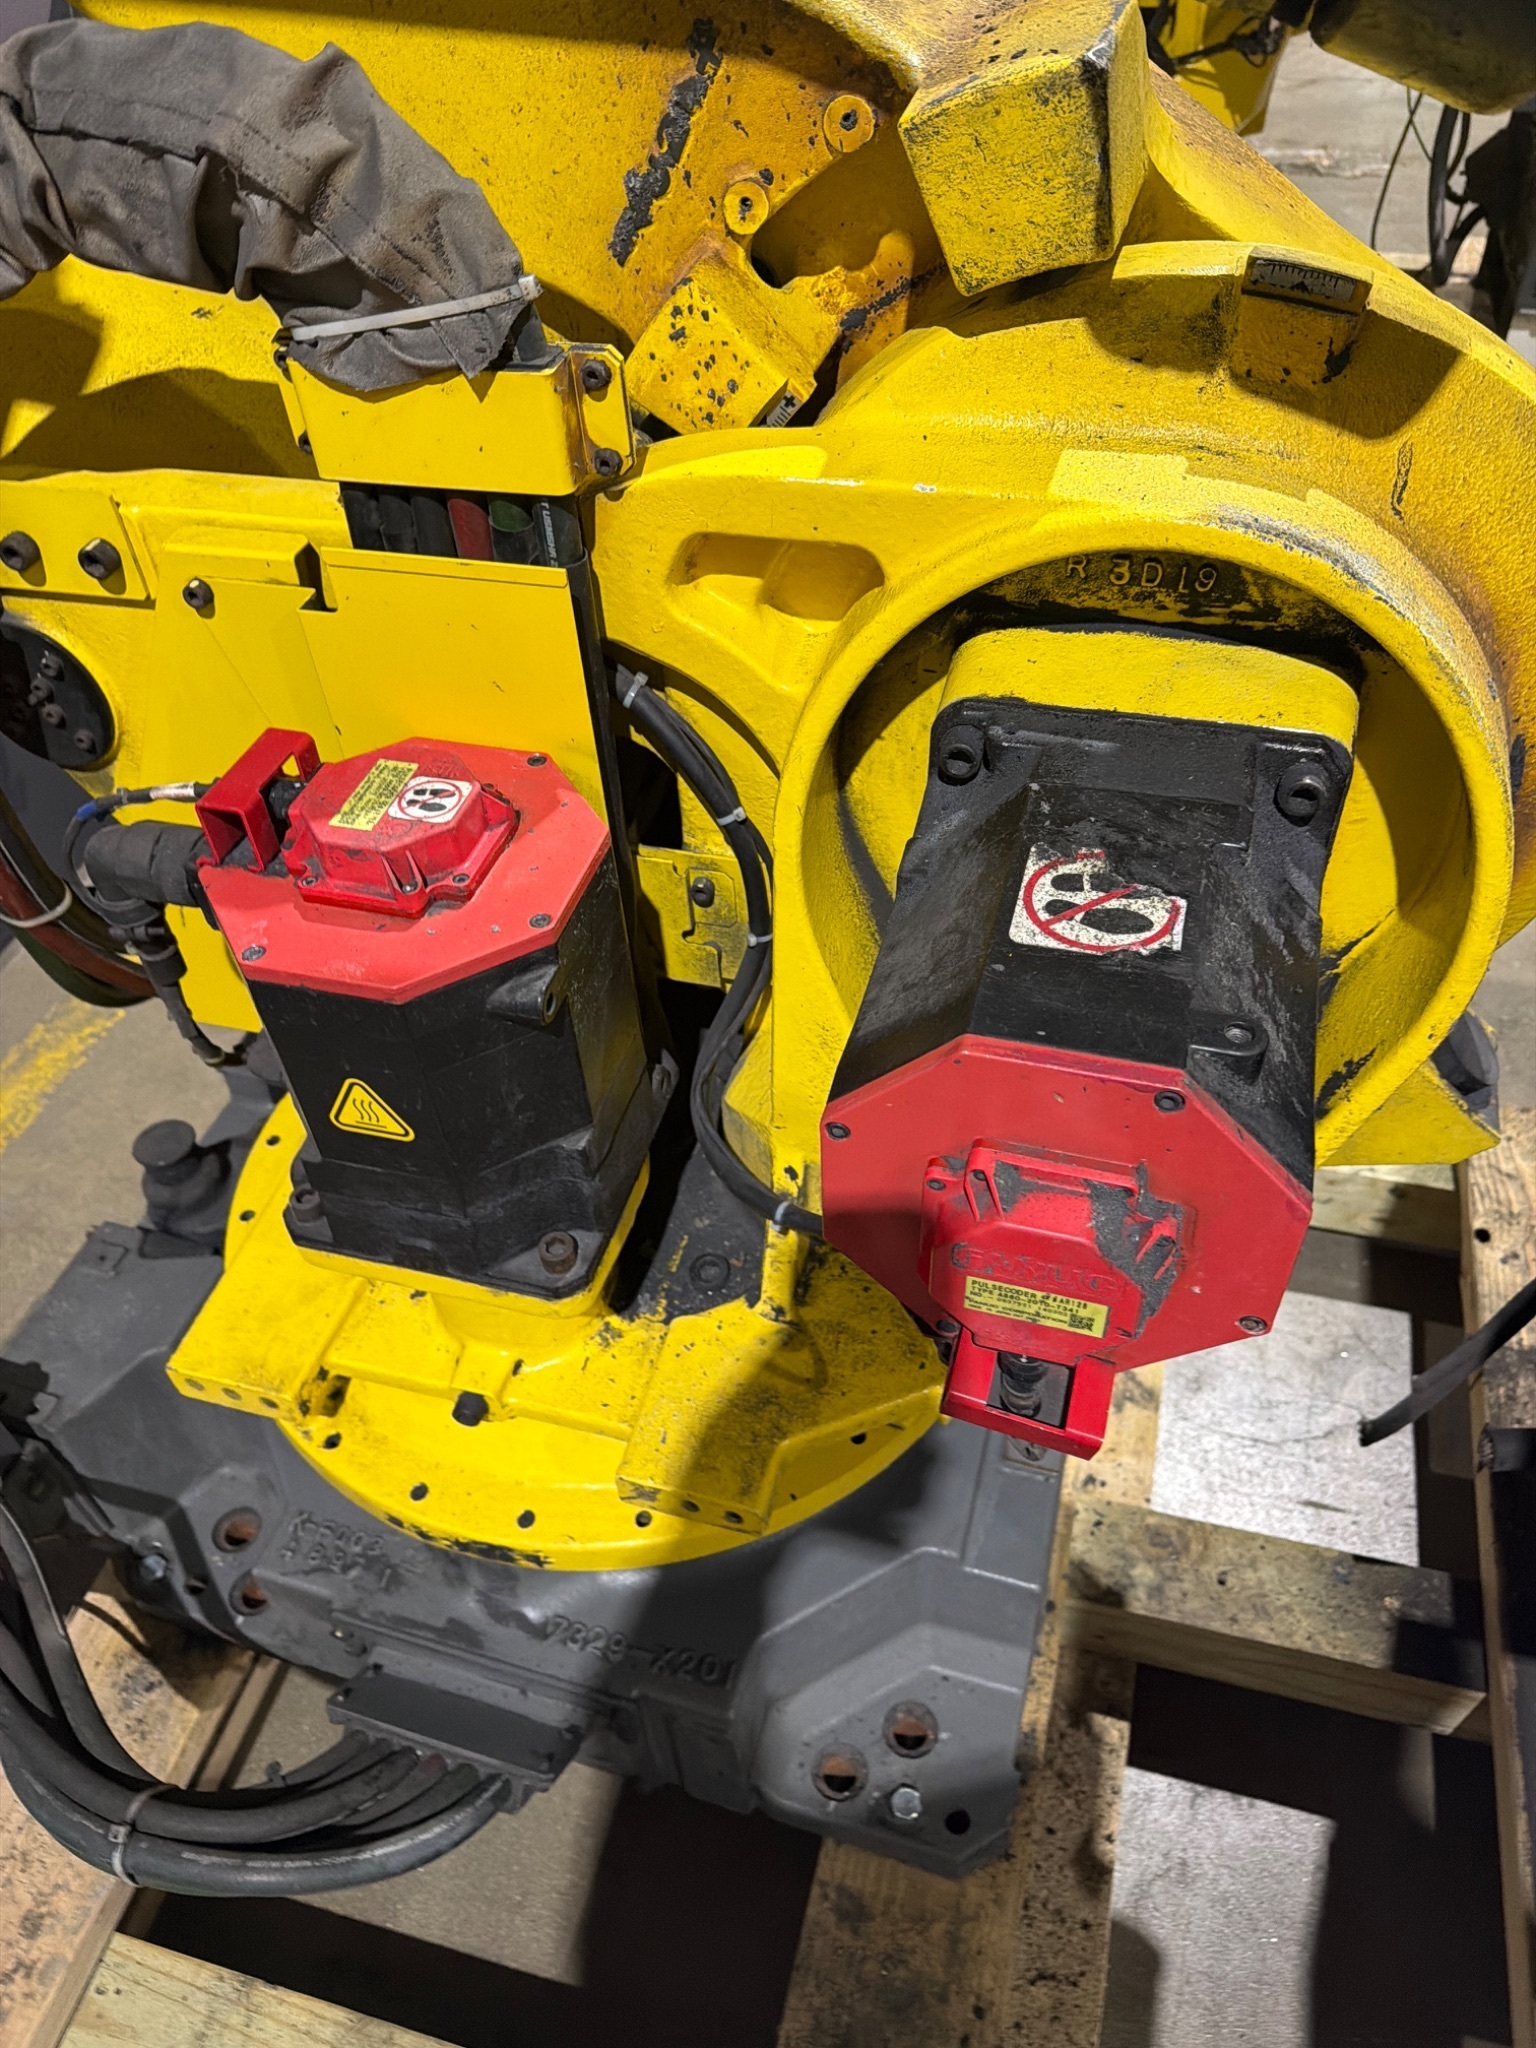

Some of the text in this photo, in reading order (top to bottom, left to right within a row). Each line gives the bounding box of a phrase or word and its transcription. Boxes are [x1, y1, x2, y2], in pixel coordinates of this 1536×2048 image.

[1066, 555, 1087, 579] R
[971, 1280, 1037, 1299] PULSECODER
[971, 1286, 993, 1296] TYPE
